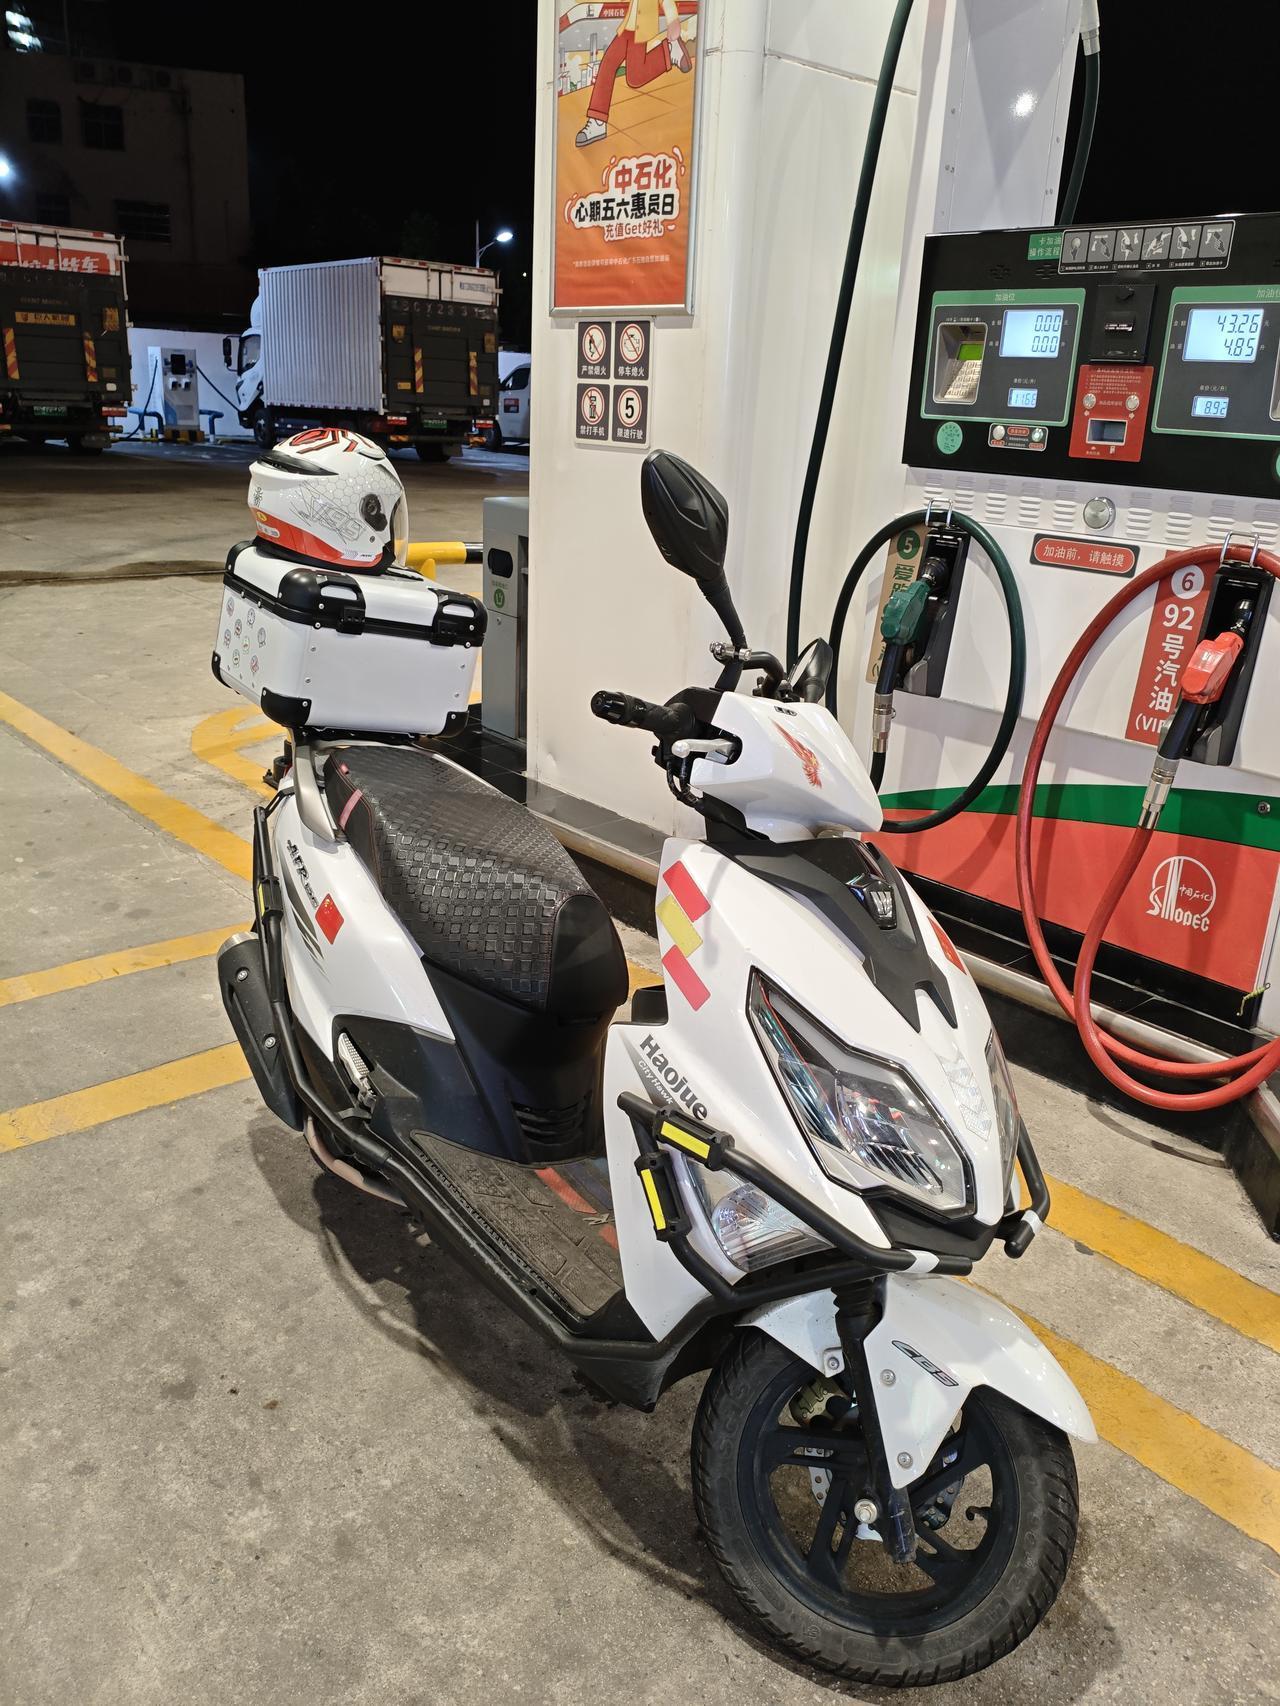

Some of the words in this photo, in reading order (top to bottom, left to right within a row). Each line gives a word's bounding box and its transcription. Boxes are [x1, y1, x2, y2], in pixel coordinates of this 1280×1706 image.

[614, 158, 673, 194] 中石化
[575, 192, 675, 223] 心期五六惠员日
[605, 219, 663, 239] 充值Get好礼
[1039, 236, 1061, 245] 卡加油
[1028, 246, 1060, 257] 操作流程
[1034, 315, 1061, 332] 0.00
[1217, 314, 1260, 333] 43.26
[1031, 335, 1058, 353] 0.00
[1224, 338, 1256, 356] 4.85
[581, 365, 607, 376] 严禁烟火
[618, 366, 645, 377] 停车熄火
[625, 397, 635, 419] 5
[580, 425, 605, 436] 禁打手机
[616, 428, 643, 439] 限速行驶
[903, 537, 914, 554] 5
[1181, 572, 1195, 591] 6
[638, 1060, 654, 1080] City
[651, 1077, 673, 1105] Hawk
[640, 1034, 708, 1121] Haojue
